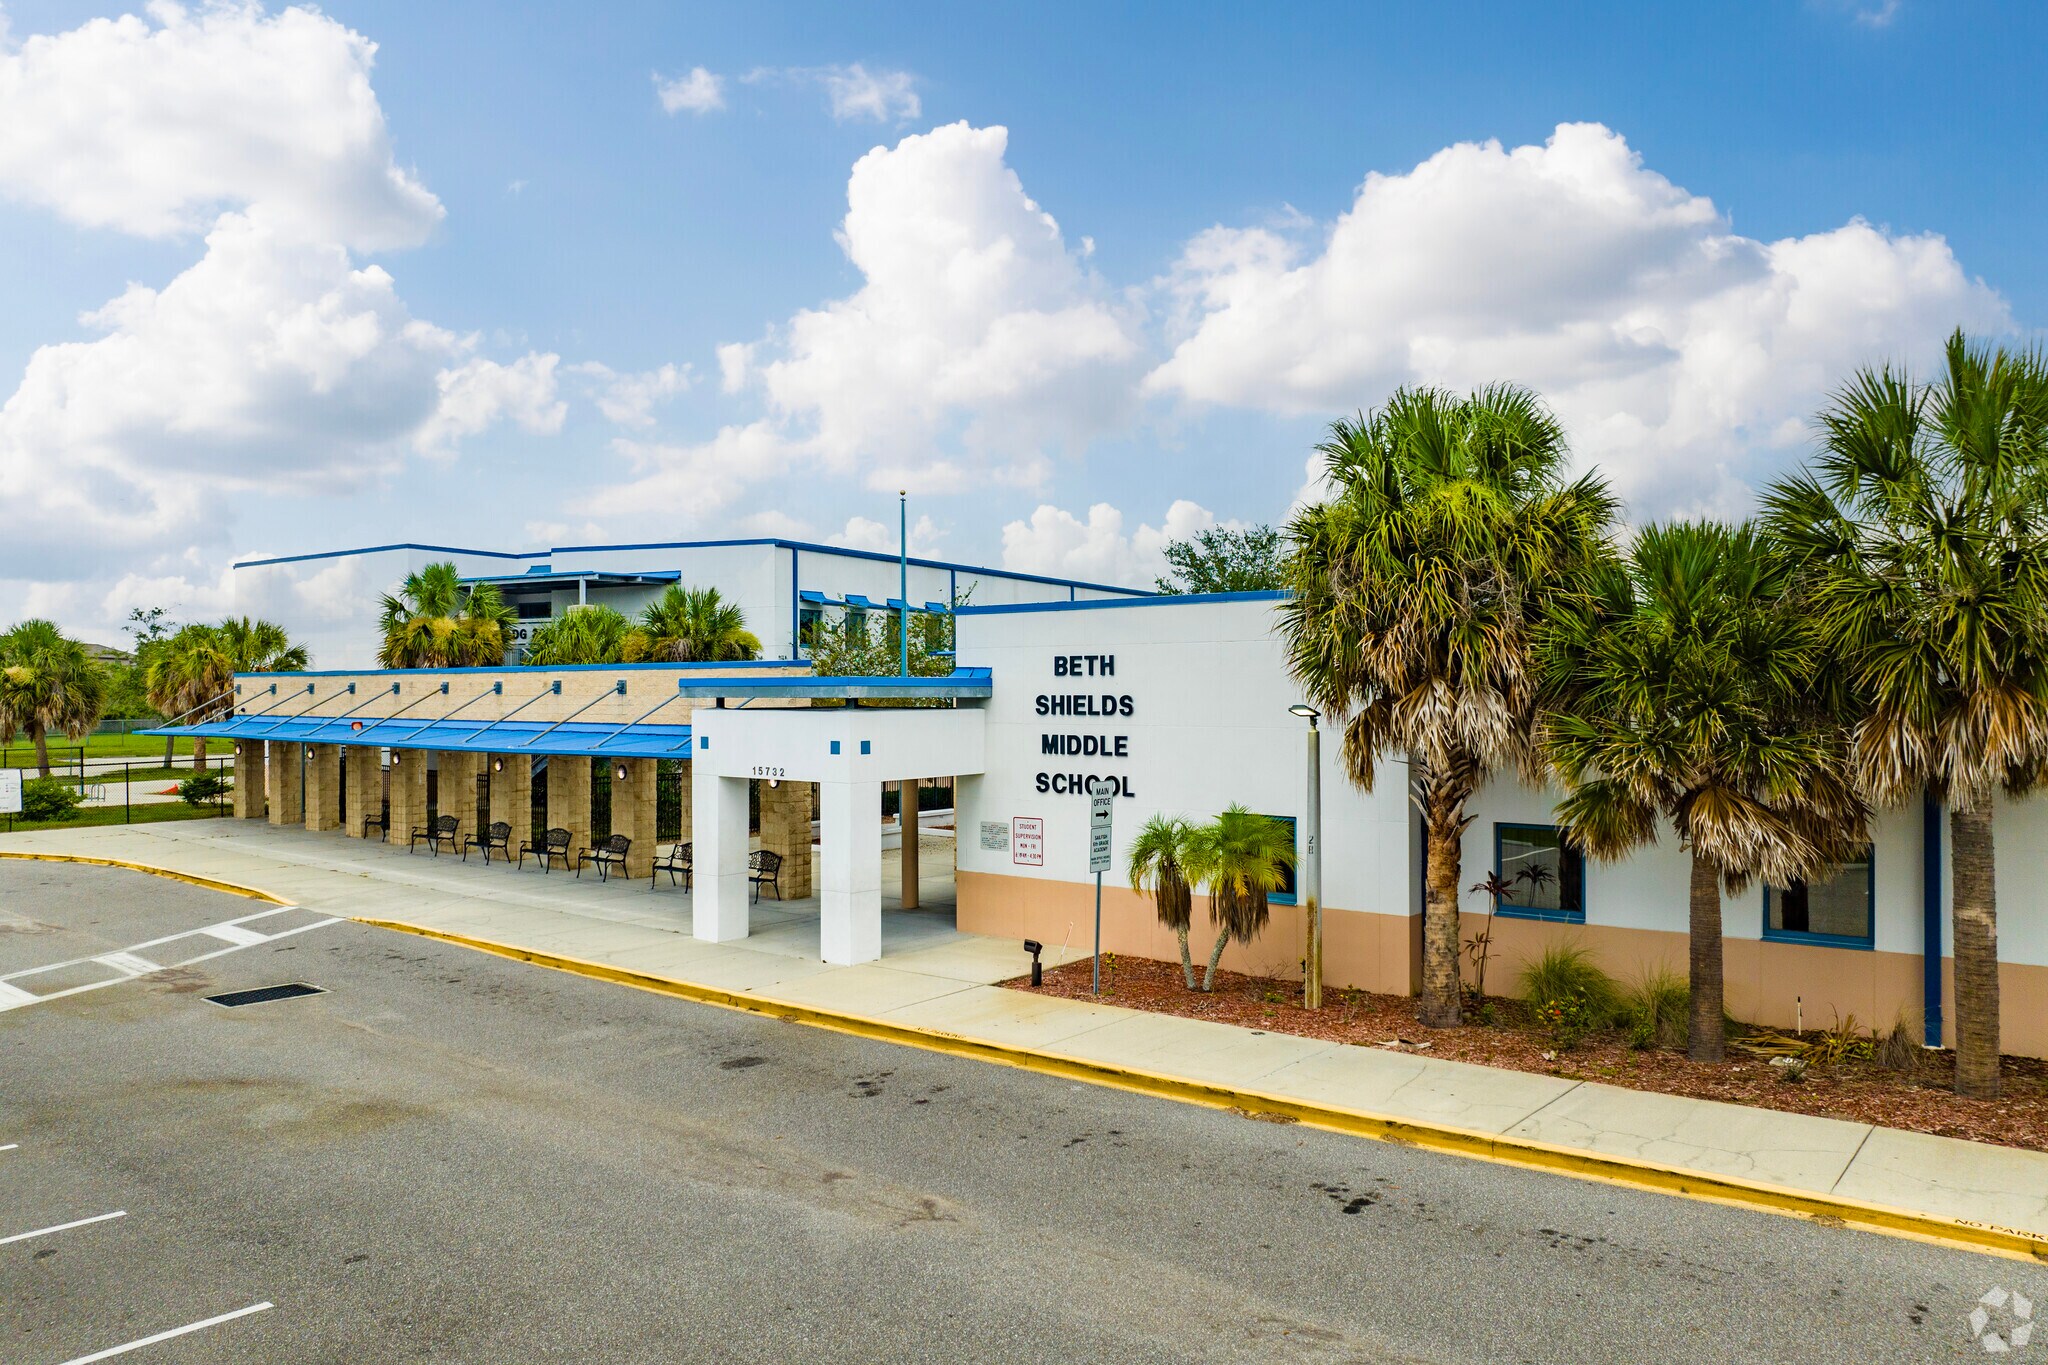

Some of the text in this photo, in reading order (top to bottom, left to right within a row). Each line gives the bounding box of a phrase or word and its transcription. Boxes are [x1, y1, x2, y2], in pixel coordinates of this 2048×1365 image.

[1054, 655, 1114, 676] BETH
[1035, 694, 1134, 717] SHIELDS
[1041, 734, 1128, 757] MIDDLE
[752, 766, 785, 776] 15732
[1036, 772, 1135, 798] SCHOOL
[1094, 798, 1111, 806] OFFICE
[1954, 1218, 2048, 1240] NO PARK
